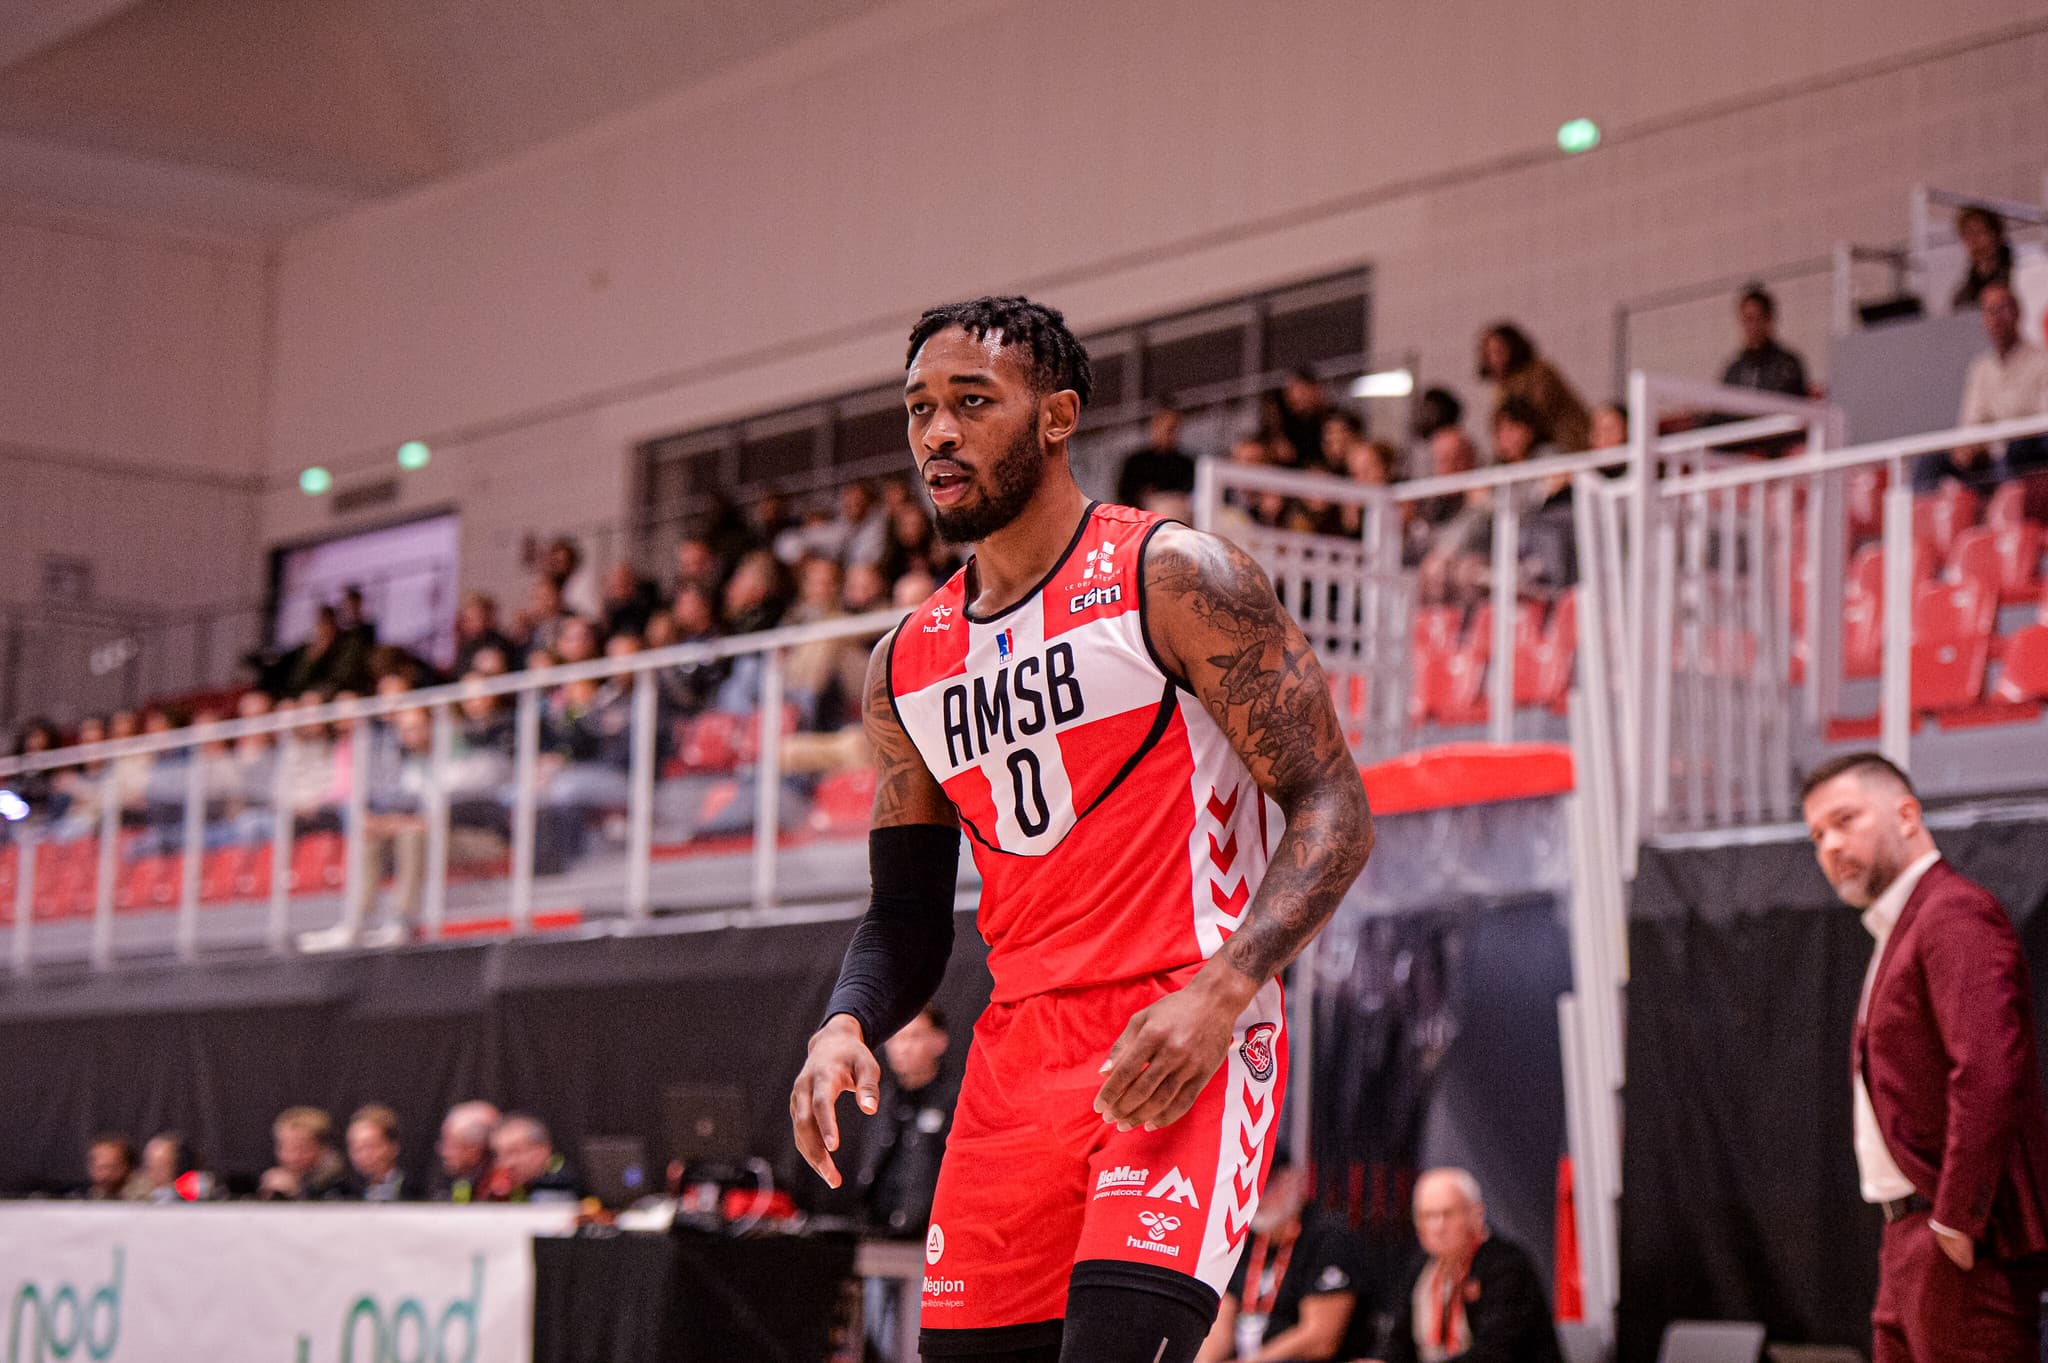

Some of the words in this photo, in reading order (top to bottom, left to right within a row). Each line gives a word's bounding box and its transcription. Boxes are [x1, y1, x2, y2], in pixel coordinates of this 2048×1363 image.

[943, 642, 1084, 768] AMSB
[1006, 748, 1050, 838] 0
[1126, 1235, 1180, 1257] hummel
